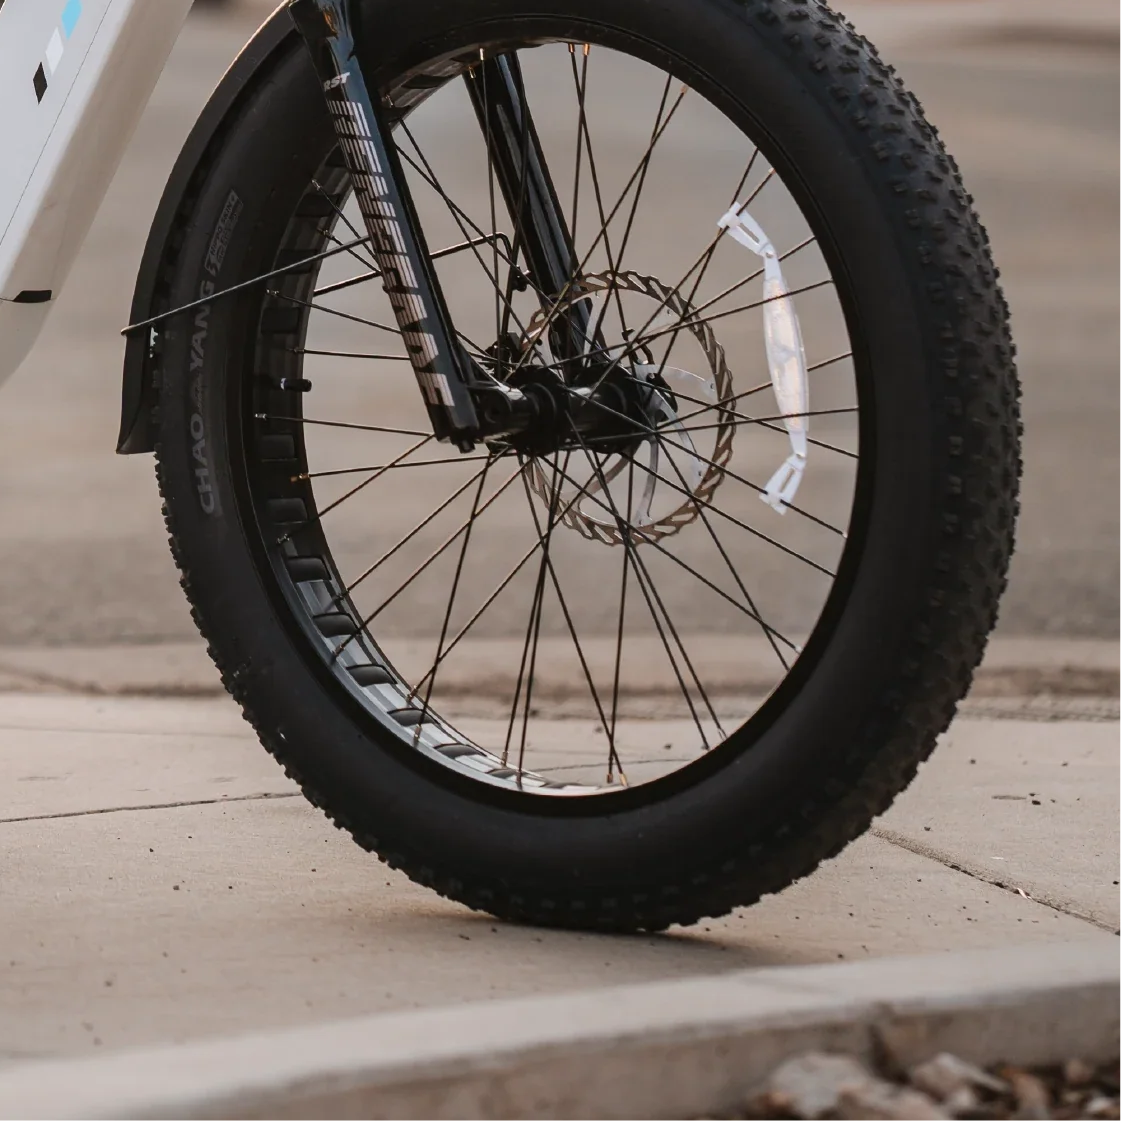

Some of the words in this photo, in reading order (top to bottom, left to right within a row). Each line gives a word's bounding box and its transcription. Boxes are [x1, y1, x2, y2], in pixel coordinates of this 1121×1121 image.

[323, 71, 350, 91] RST
[189, 279, 215, 372] YANG
[189, 412, 215, 514] CHAO
